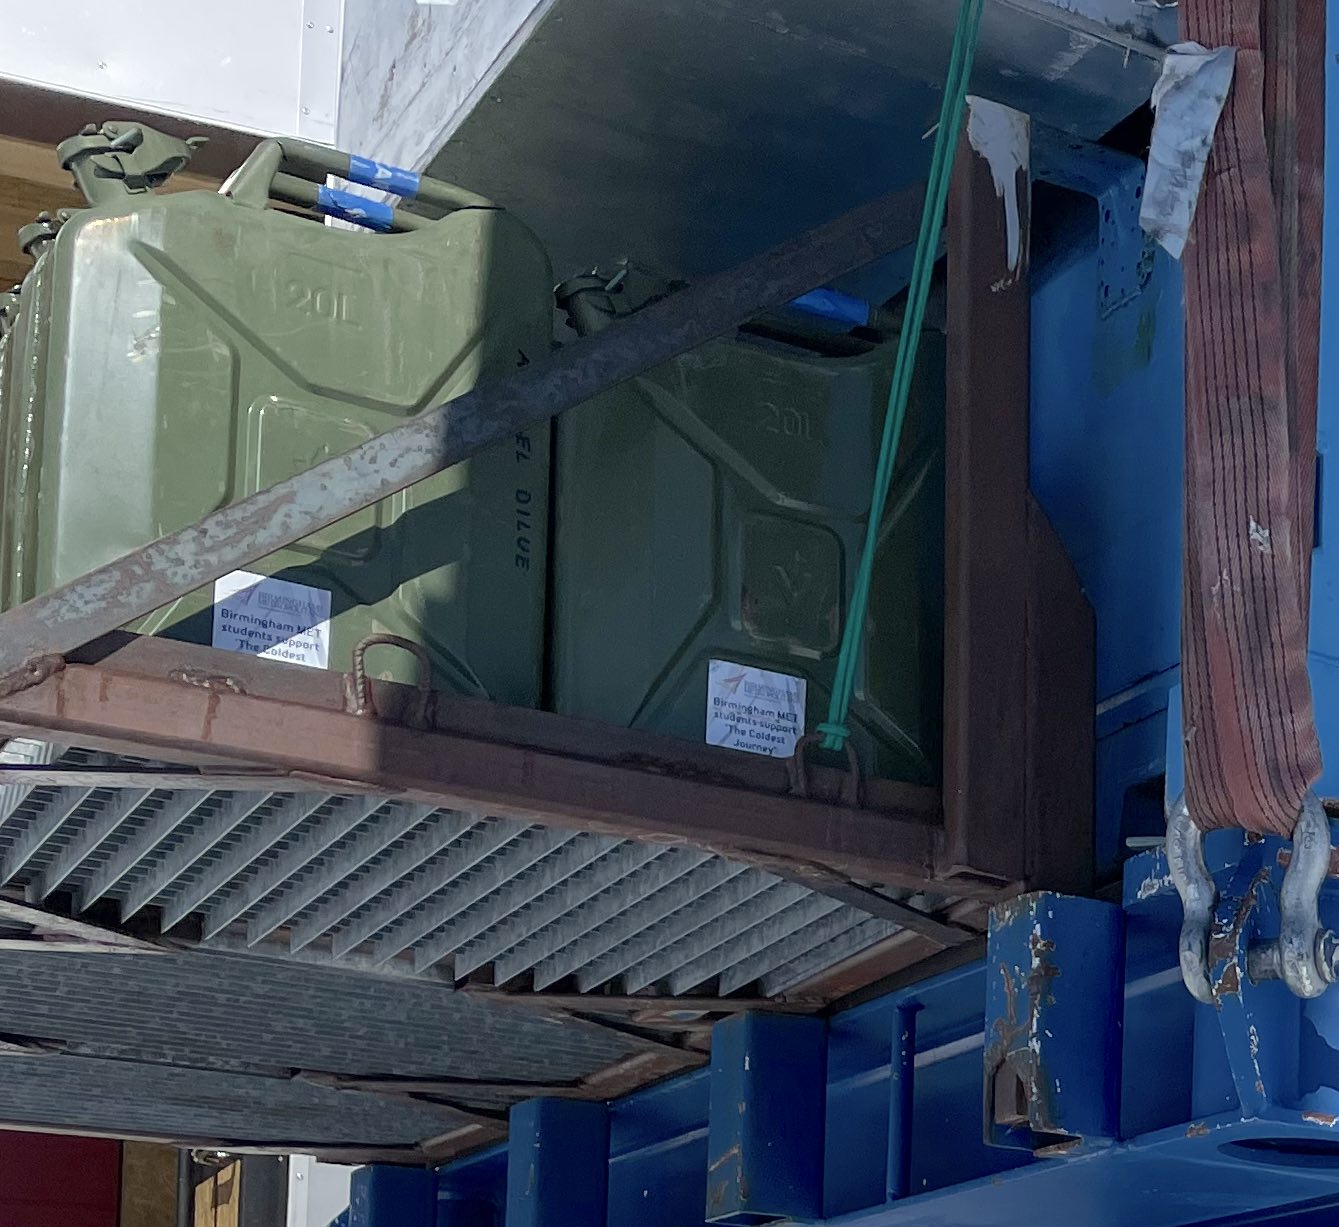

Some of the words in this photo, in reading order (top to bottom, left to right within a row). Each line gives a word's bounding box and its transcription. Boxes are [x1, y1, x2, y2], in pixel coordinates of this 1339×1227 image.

[221, 608, 294, 633] Birmingham
[298, 624, 322, 639] MET
[221, 624, 273, 642] students
[275, 635, 320, 652] support
[263, 644, 306, 662] Coldest
[713, 696, 775, 718] Birmingham
[778, 710, 798, 724] MET
[714, 711, 757, 726] students
[760, 721, 797, 735] support
[749, 729, 786, 745] Coldest
